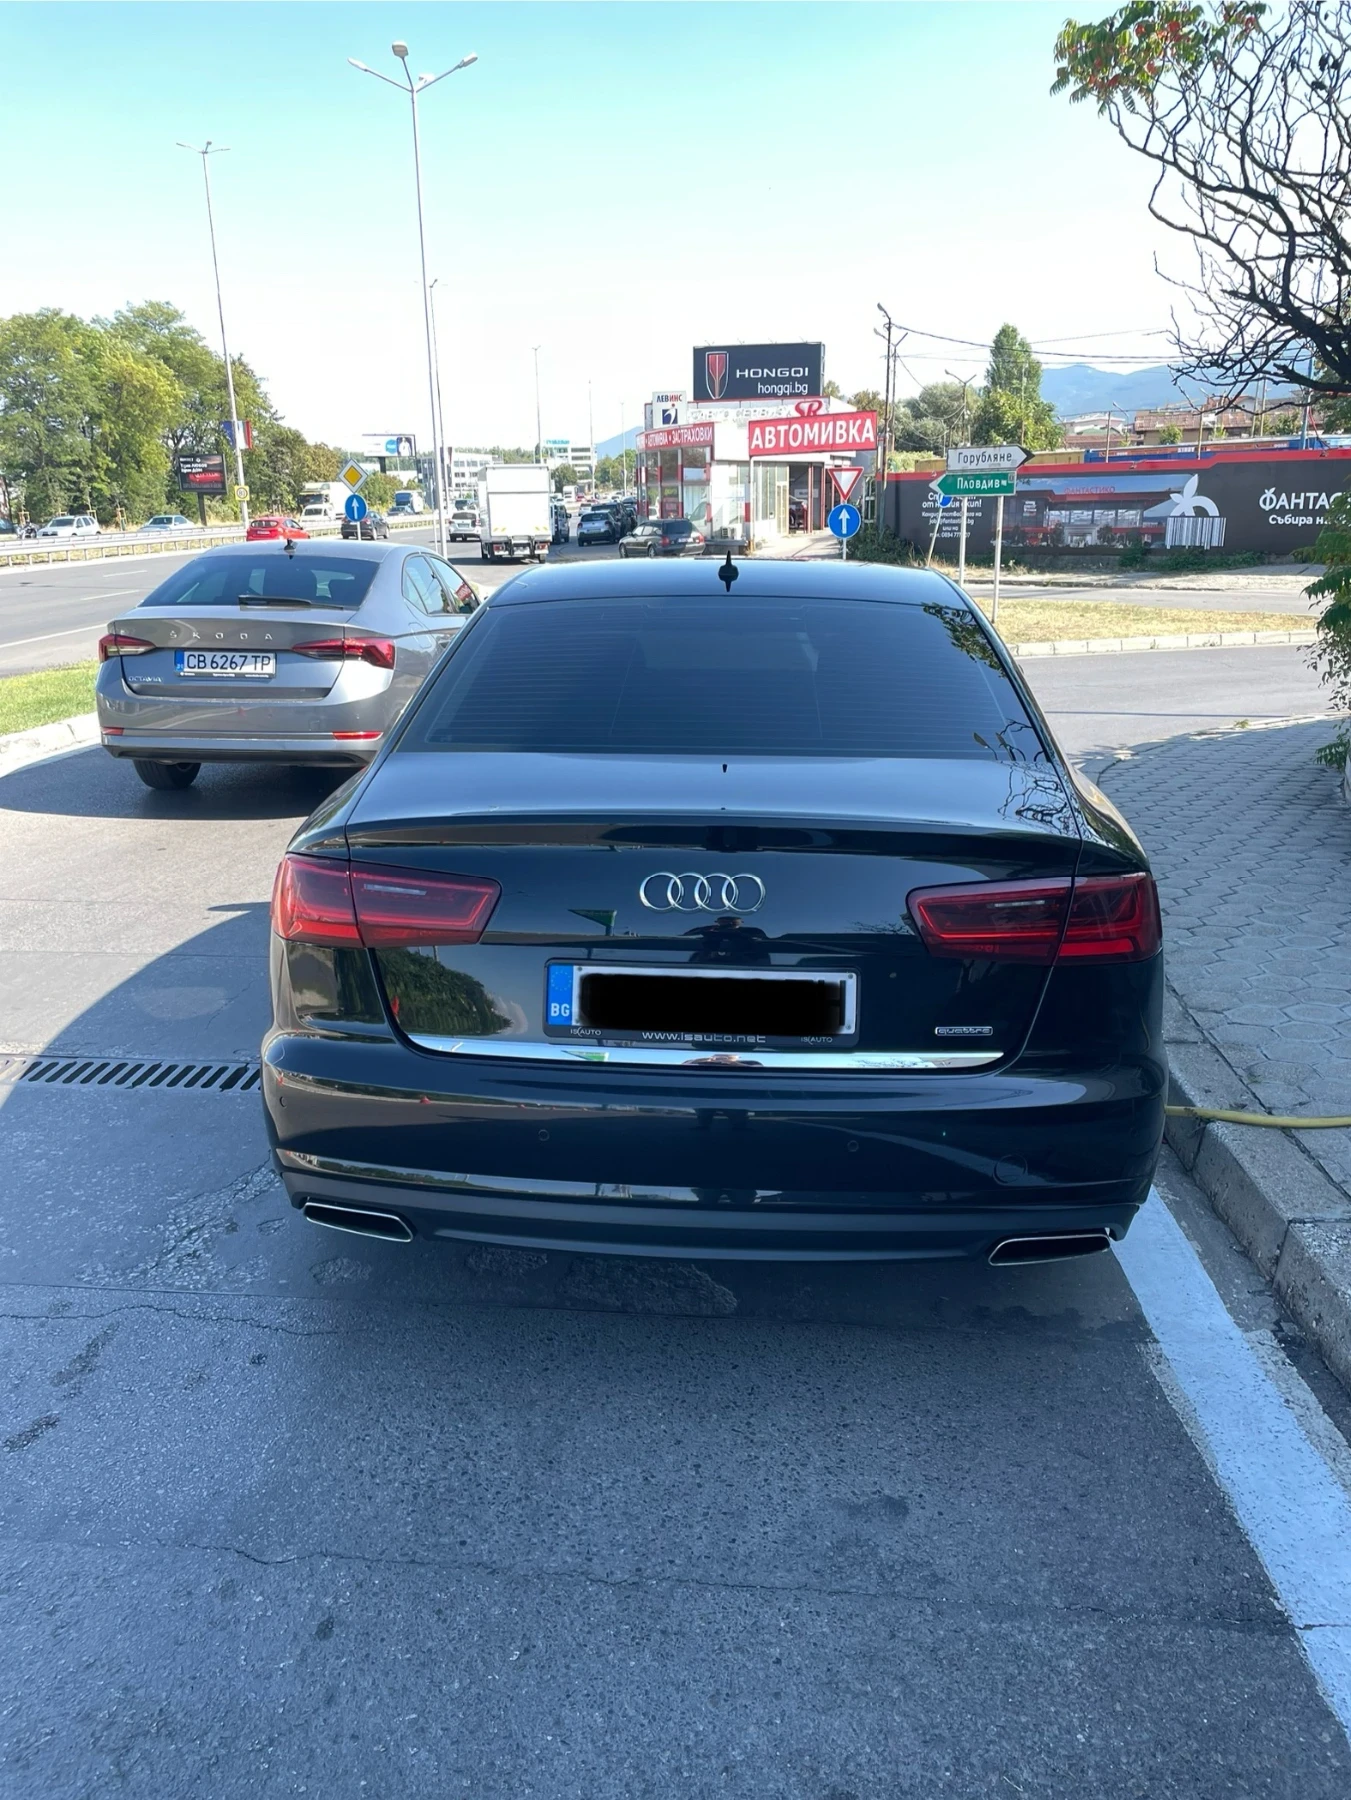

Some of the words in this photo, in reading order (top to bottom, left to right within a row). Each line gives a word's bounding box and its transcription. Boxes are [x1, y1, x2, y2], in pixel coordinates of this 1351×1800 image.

[736, 367, 809, 378] HONGQI
[757, 382, 809, 396] hongqi.bg
[656, 394, 683, 403] ЛЕВИНС
[671, 426, 713, 444] ЗАСТРАХОВКИ
[750, 417, 875, 450] АВТОМИВКА
[957, 451, 1012, 466] Горубляне
[956, 477, 1001, 490] Пловдив
[1063, 486, 1116, 495] ФАНТАСТИКО
[1268, 514, 1313, 527] Събира
[186, 653, 207, 670] CB
[210, 654, 248, 671] 6267
[251, 655, 271, 671] TP
[550, 1003, 570, 1017] BG
[642, 1030, 766, 1044] www.isauto.net
[937, 1027, 991, 1036] quattro
